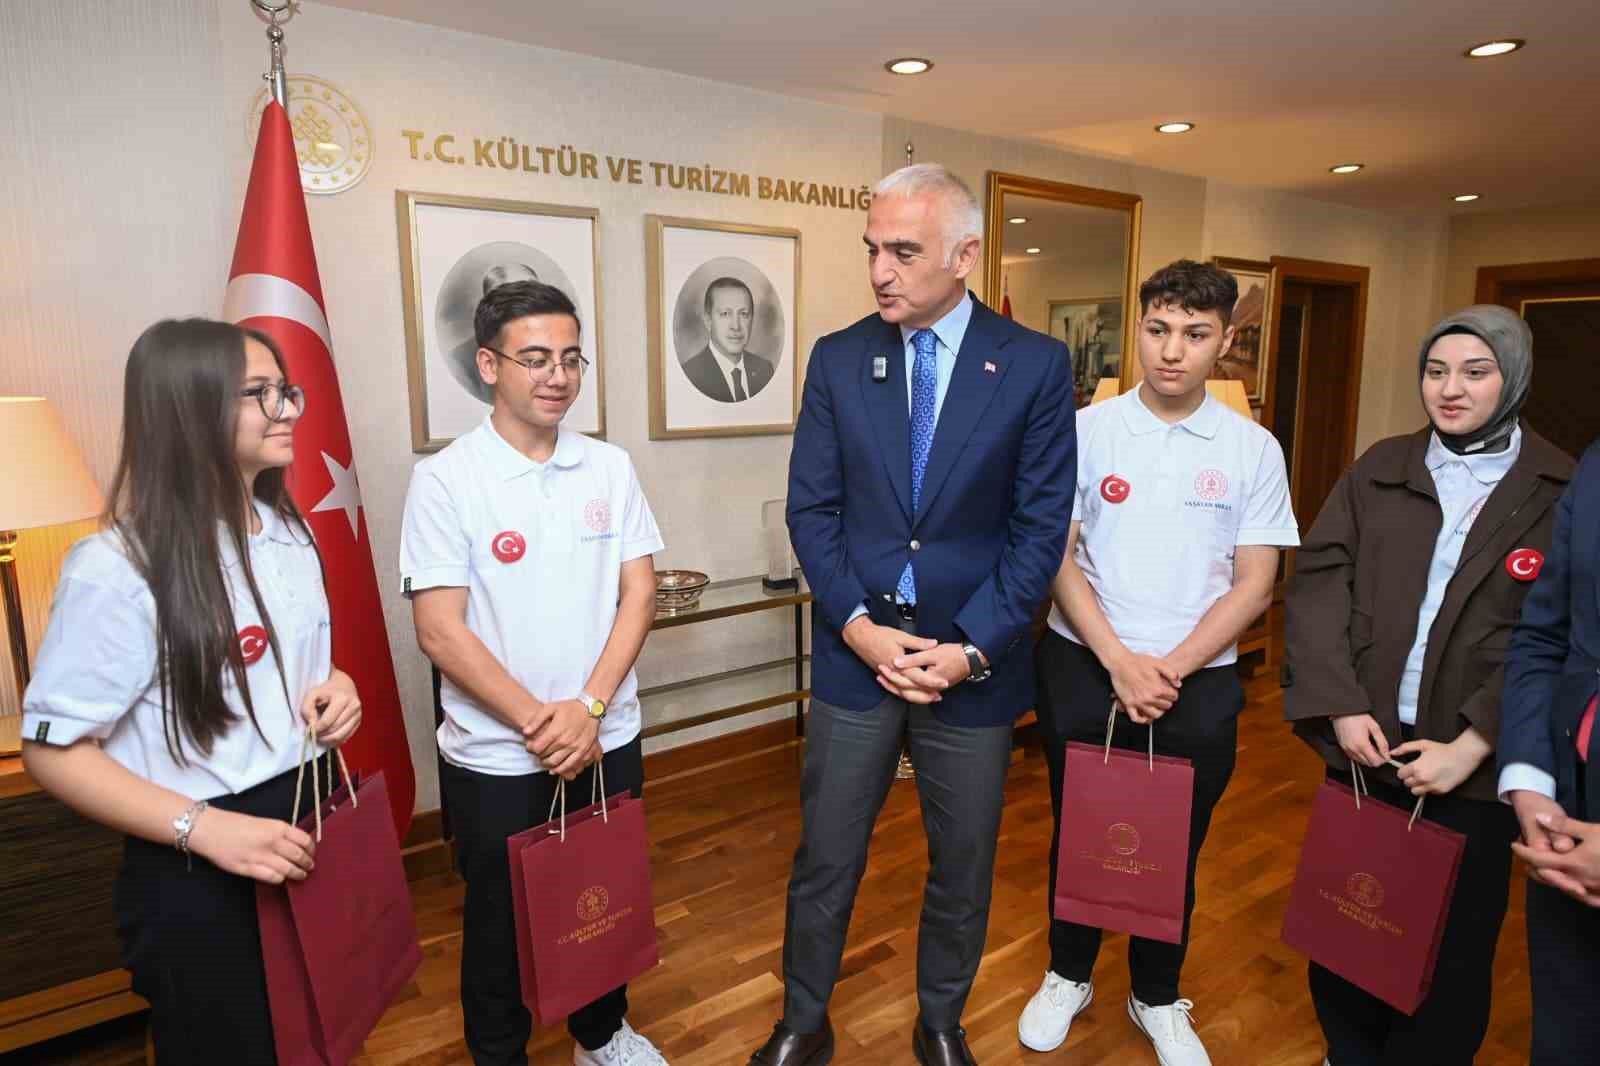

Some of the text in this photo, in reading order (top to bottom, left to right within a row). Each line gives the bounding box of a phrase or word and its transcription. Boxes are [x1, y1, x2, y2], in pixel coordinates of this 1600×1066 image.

[401, 129, 876, 212] T.C. KÜLTÜR VE TURİZM BAKANLIĞ
